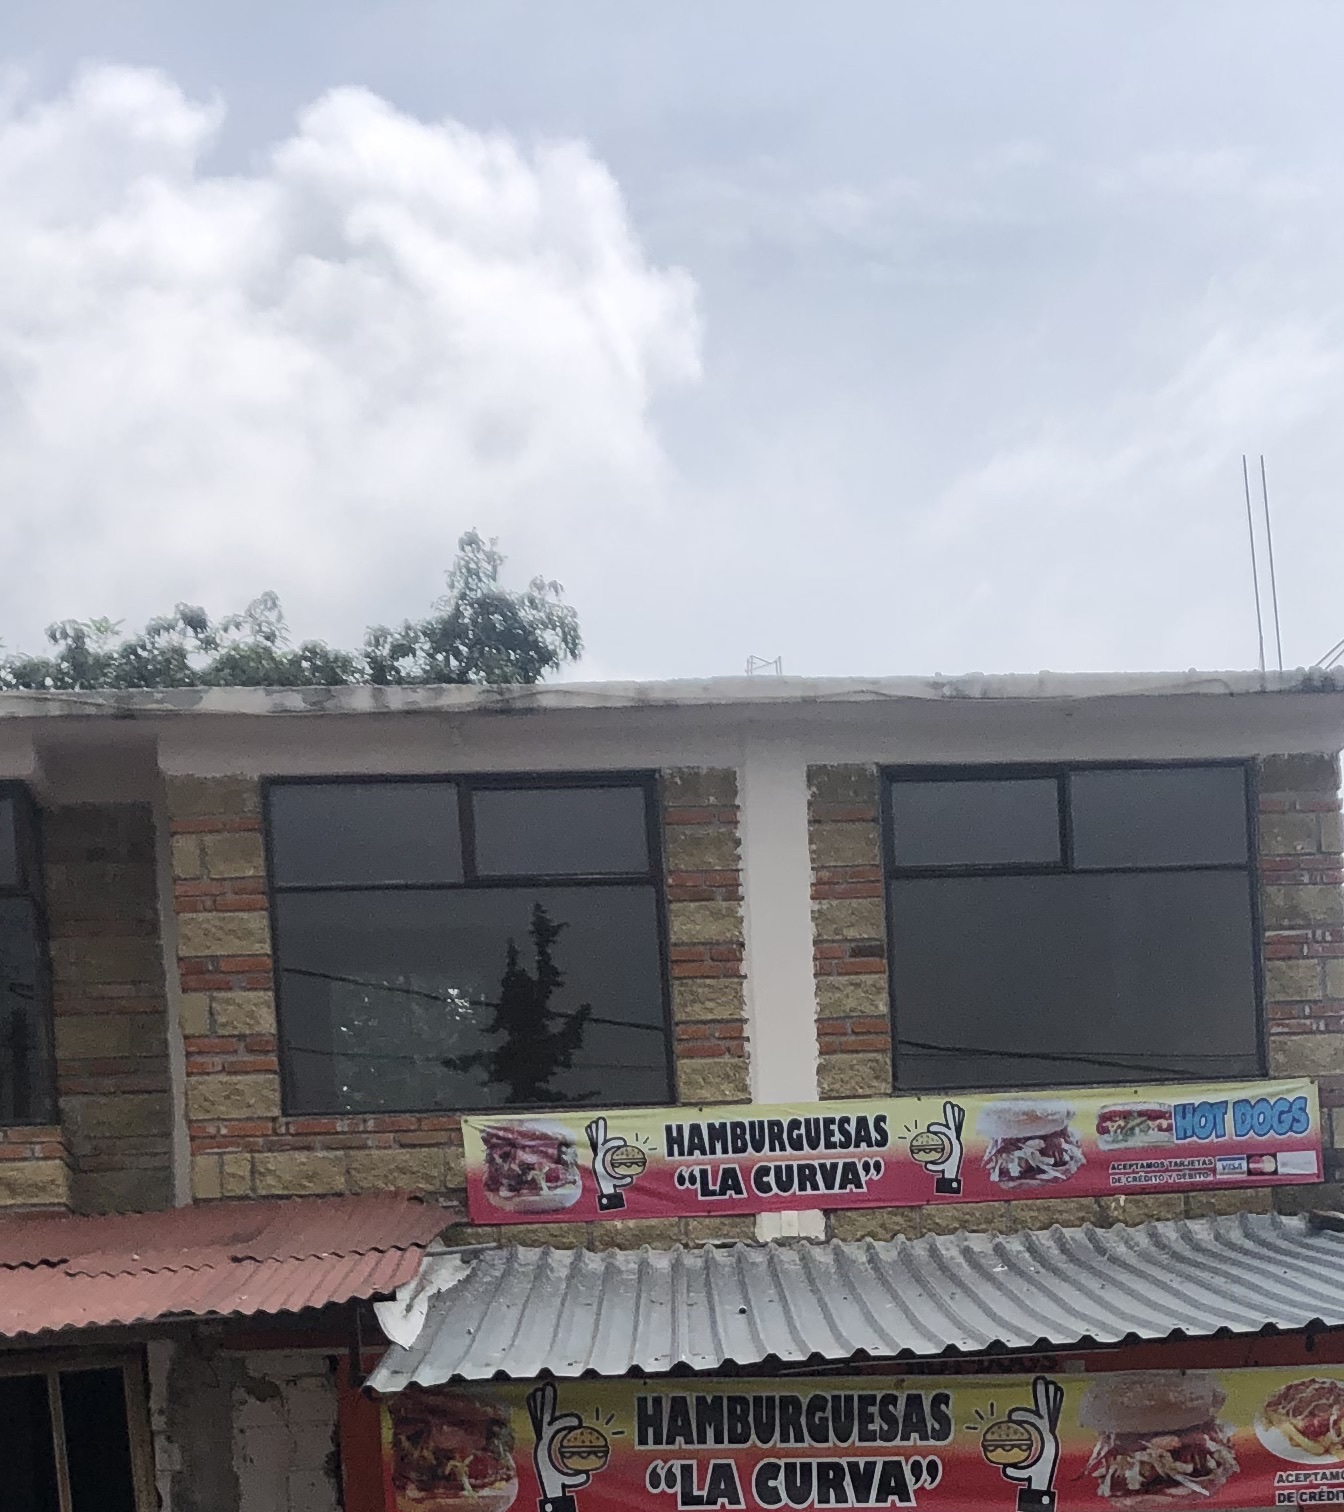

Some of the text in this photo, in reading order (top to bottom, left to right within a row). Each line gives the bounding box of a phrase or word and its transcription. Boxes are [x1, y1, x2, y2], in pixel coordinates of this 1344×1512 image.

[1173, 1096, 1310, 1140] HOT DOGS
[664, 1114, 889, 1158] HAMBURGUESAS
[1110, 1156, 1214, 1172] ACEPTAMOS TARJETAS
[1221, 1162, 1243, 1172] VISA
[1111, 1175, 1123, 1185] DE
[1168, 1173, 1174, 1182] Y
[636, 1391, 953, 1446] HAMBURGUESAS
[1277, 1491, 1296, 1504] DE
